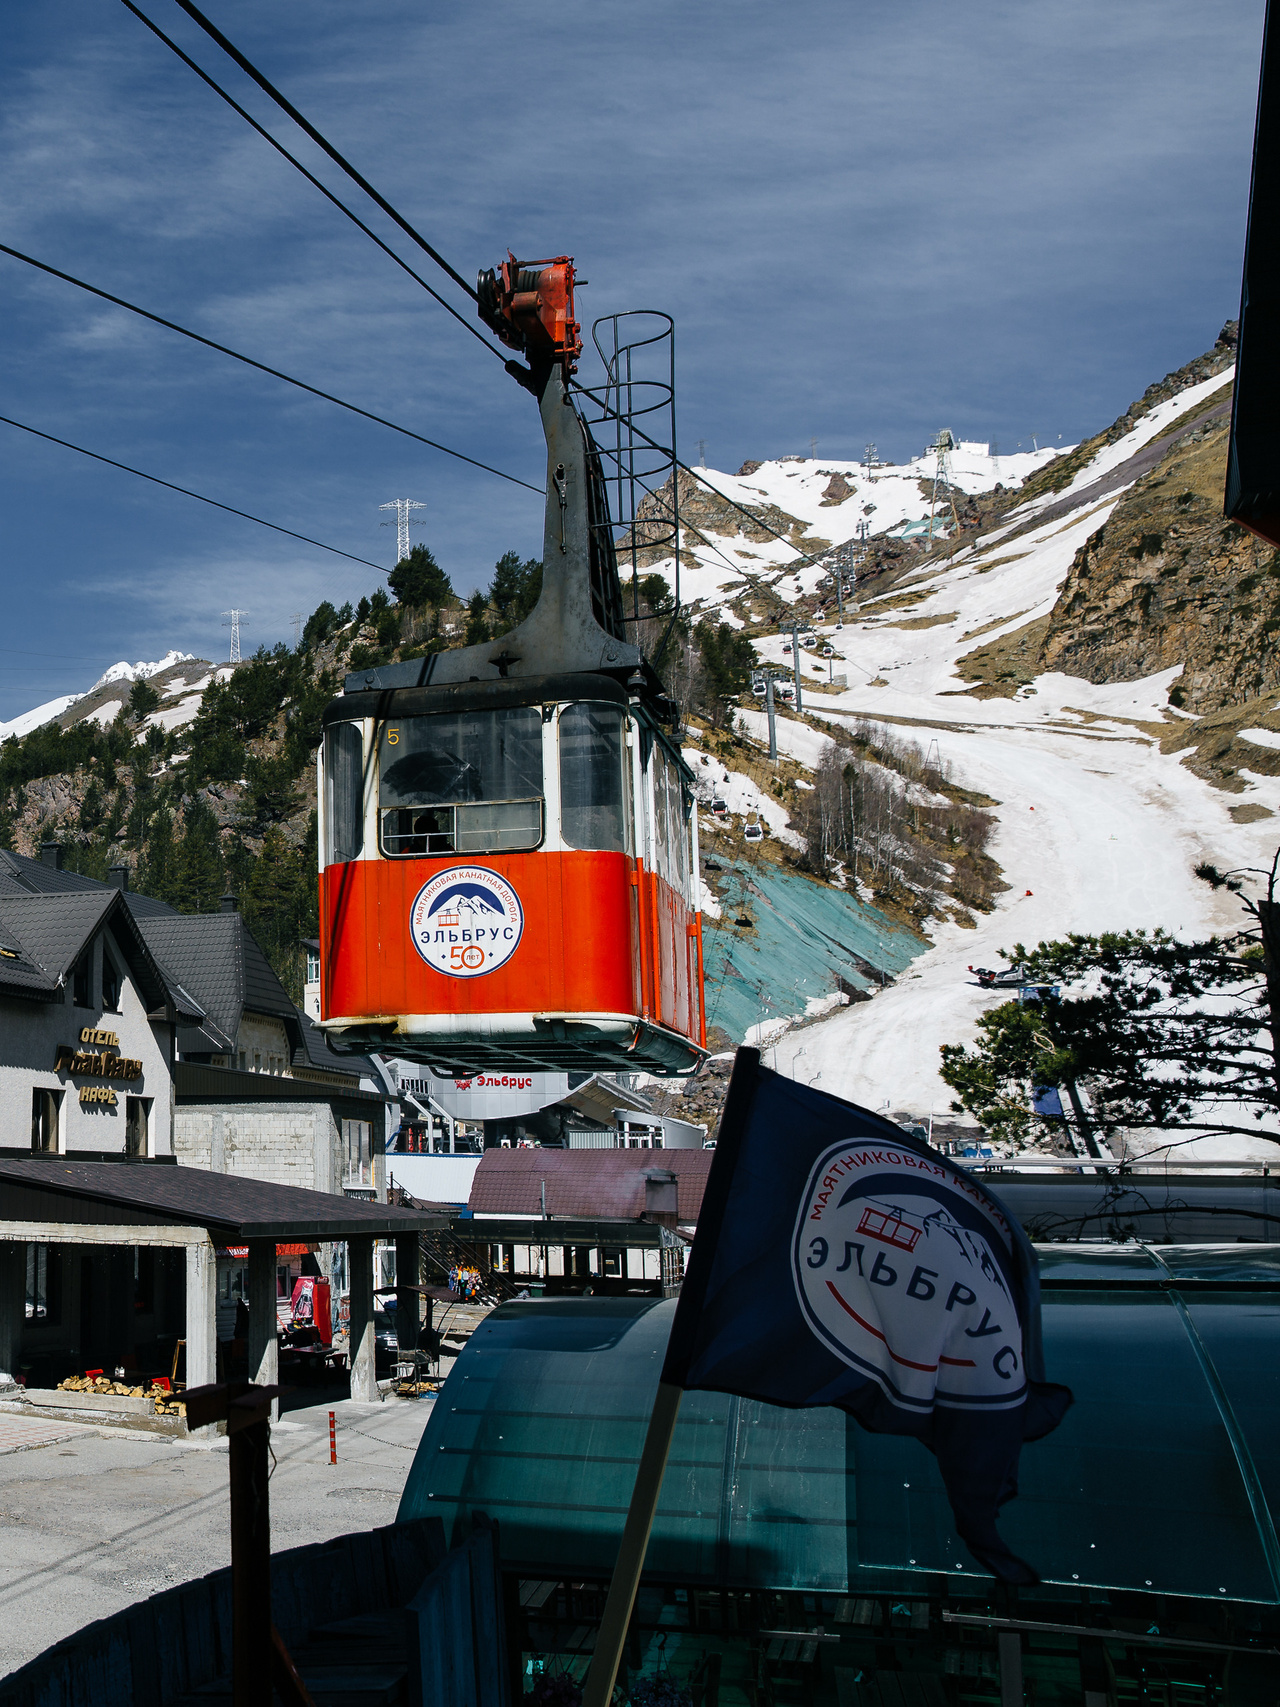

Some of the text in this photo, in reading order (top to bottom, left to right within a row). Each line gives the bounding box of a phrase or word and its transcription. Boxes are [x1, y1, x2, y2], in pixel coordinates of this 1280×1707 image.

[388, 728, 400, 745] 5
[415, 871, 518, 925] МАЯТНИКОВАЯ КАНАТНАЯ ДОРОГА
[420, 927, 514, 944] ЭЛЬБРУС
[450, 945, 485, 970] 50
[80, 1027, 120, 1046] ОТЕЛЬ
[477, 1075, 533, 1089] Эльбрус
[80, 1086, 118, 1104] КАФЕ
[810, 1151, 946, 1221] МАЯТНИКОВАЯ
[806, 1236, 1018, 1380] ЭЛЬБРУС
